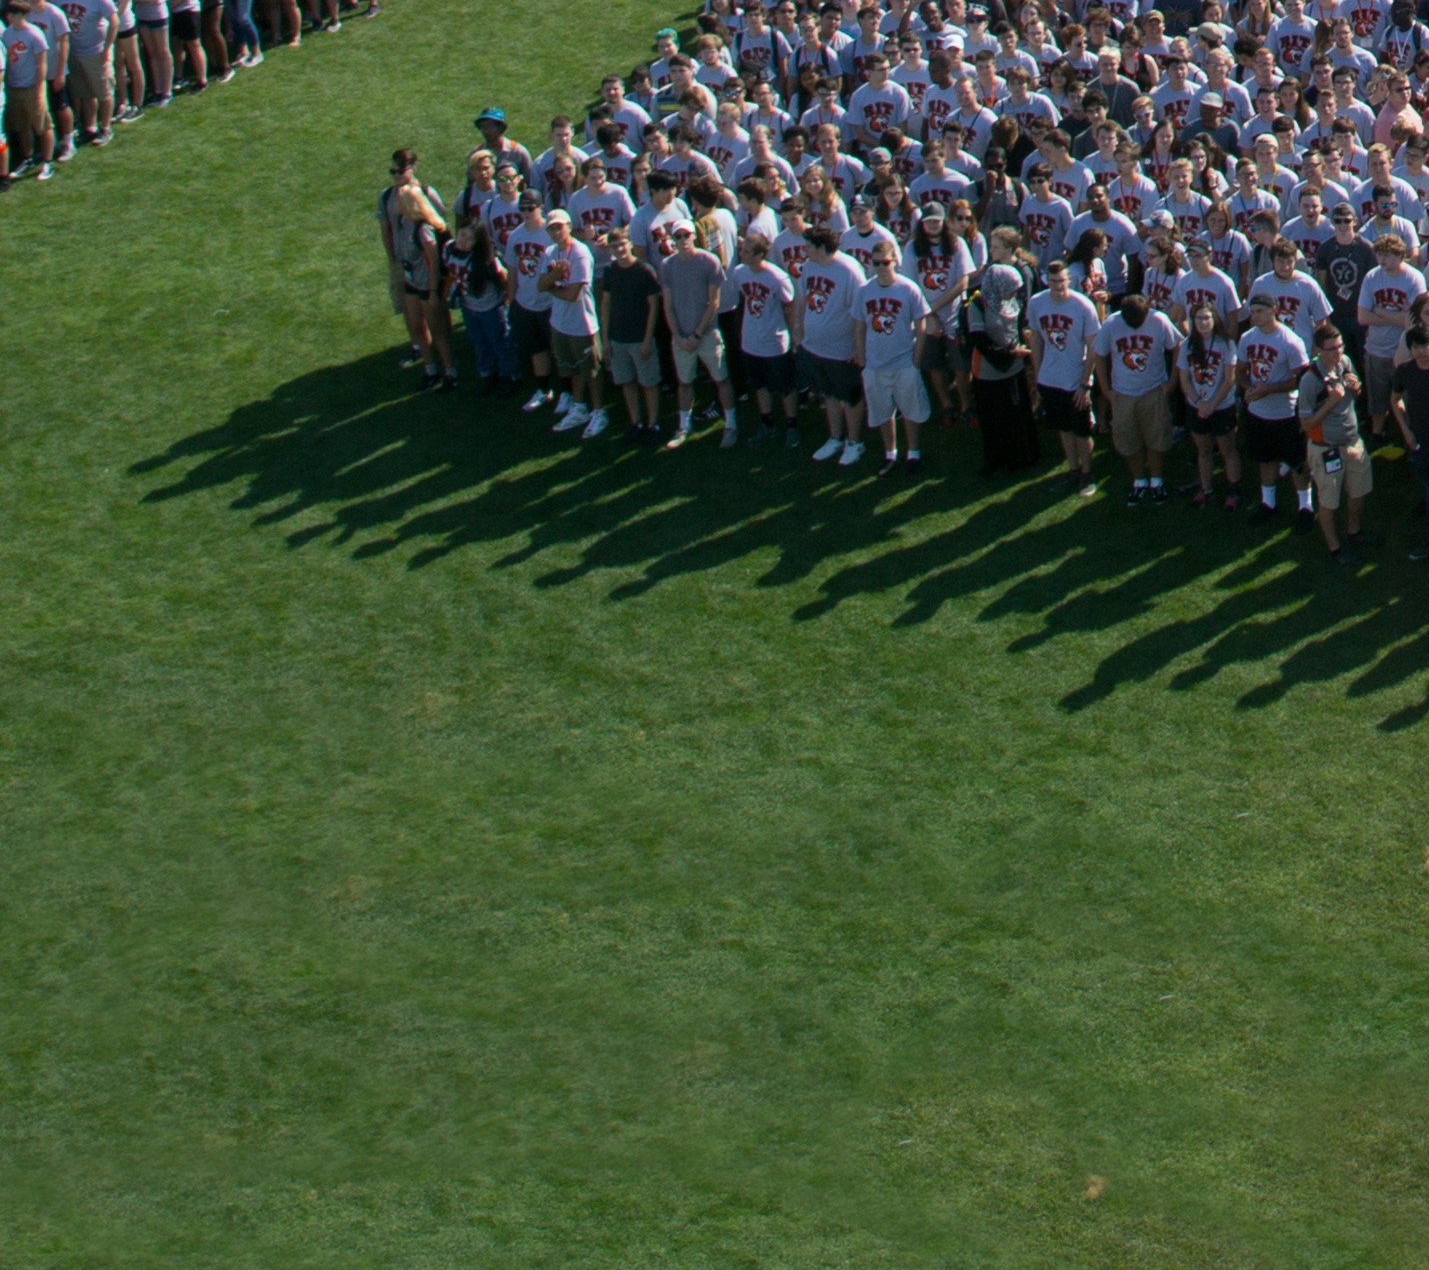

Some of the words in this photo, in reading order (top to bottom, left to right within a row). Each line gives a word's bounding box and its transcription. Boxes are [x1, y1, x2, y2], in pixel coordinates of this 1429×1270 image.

[1351, 8, 1380, 24] RIT
[1280, 35, 1310, 50] RIT
[863, 102, 894, 118] RIT
[581, 208, 614, 225] RIT
[1026, 214, 1056, 230] RIT
[514, 242, 544, 261] RIT
[917, 257, 953, 274] RIT
[806, 276, 835, 293] RIT
[1374, 288, 1407, 306] RIT
[866, 298, 902, 318] RIT
[1039, 314, 1073, 332] RIT
[1116, 335, 1153, 355] RIT
[1246, 344, 1278, 365] RIT
